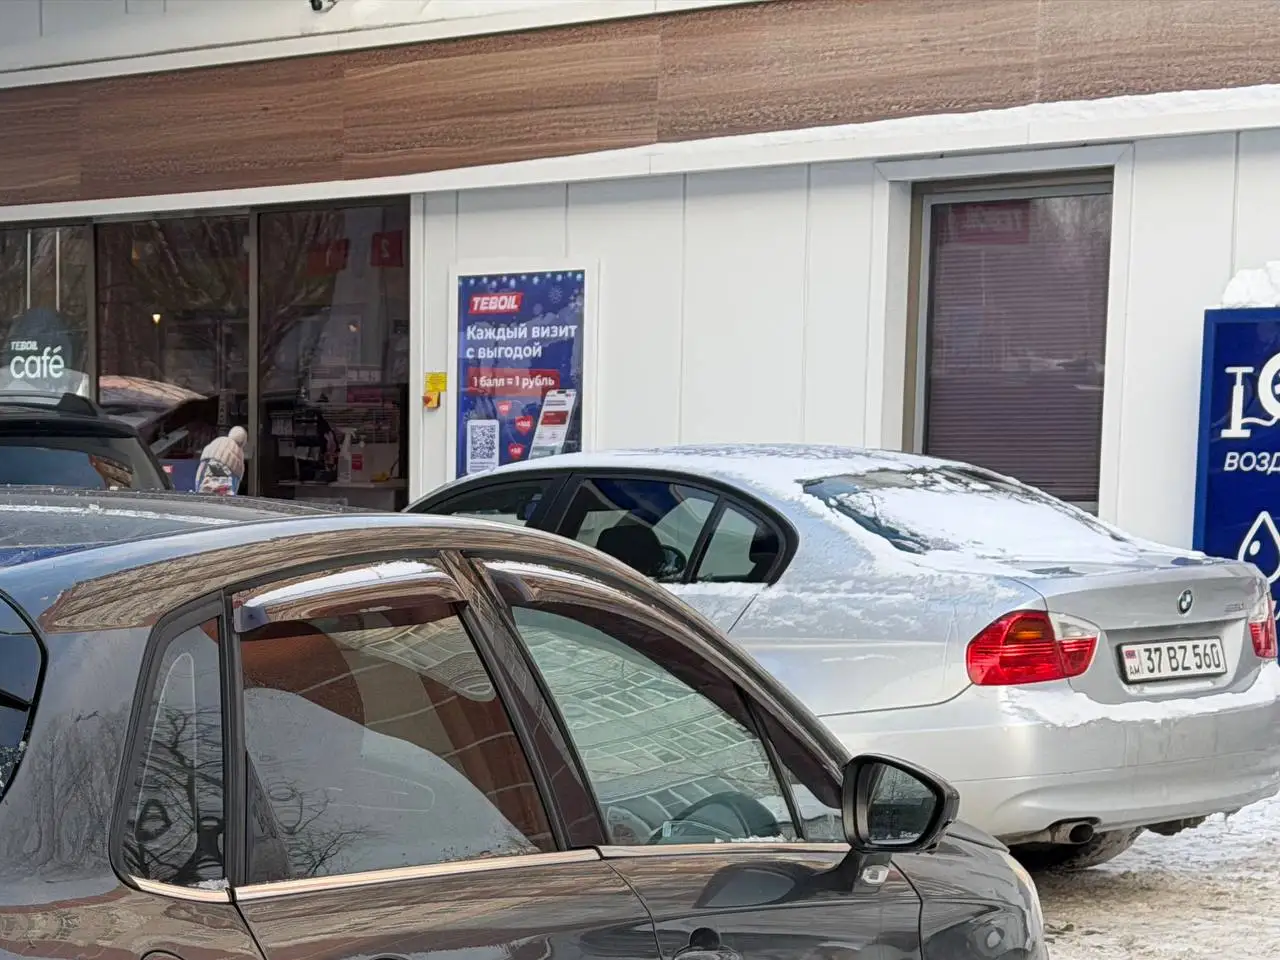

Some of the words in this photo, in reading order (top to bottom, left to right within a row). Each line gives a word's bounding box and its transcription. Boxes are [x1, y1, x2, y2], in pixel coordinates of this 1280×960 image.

[472, 295, 519, 311] TEBOIL
[466, 323, 528, 341] Каждый
[532, 325, 579, 338] визит
[466, 347, 475, 359] с
[478, 342, 542, 360] выгодой
[10, 345, 65, 379] café
[472, 377, 478, 387] 1
[480, 376, 505, 387] балл
[516, 376, 520, 386] 1
[522, 375, 555, 389] рубль
[1143, 647, 1162, 673] 37
[1167, 645, 1191, 672] BZ
[1192, 643, 1221, 669] 560
[1129, 665, 1140, 676] AM
